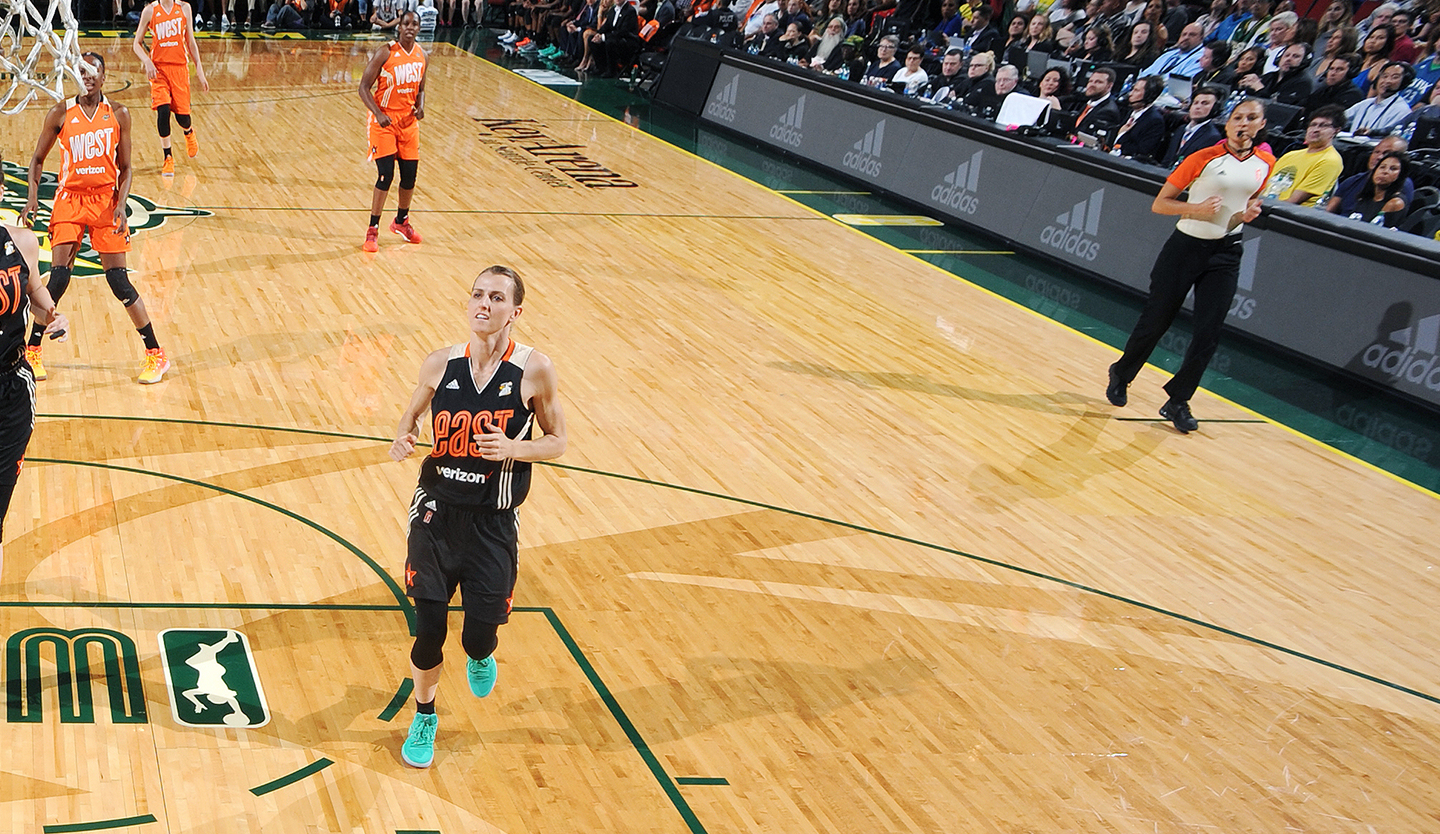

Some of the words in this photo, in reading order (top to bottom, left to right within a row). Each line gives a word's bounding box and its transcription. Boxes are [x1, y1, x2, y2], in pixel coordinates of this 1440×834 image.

[709, 102, 737, 123] adidas
[769, 122, 803, 148] adidas
[75, 165, 106, 175] verizon
[842, 149, 882, 178] adidas
[931, 182, 979, 215] adidas
[1039, 224, 1100, 262] adidas
[1363, 343, 1440, 392] adida
[435, 465, 486, 485] verizon
